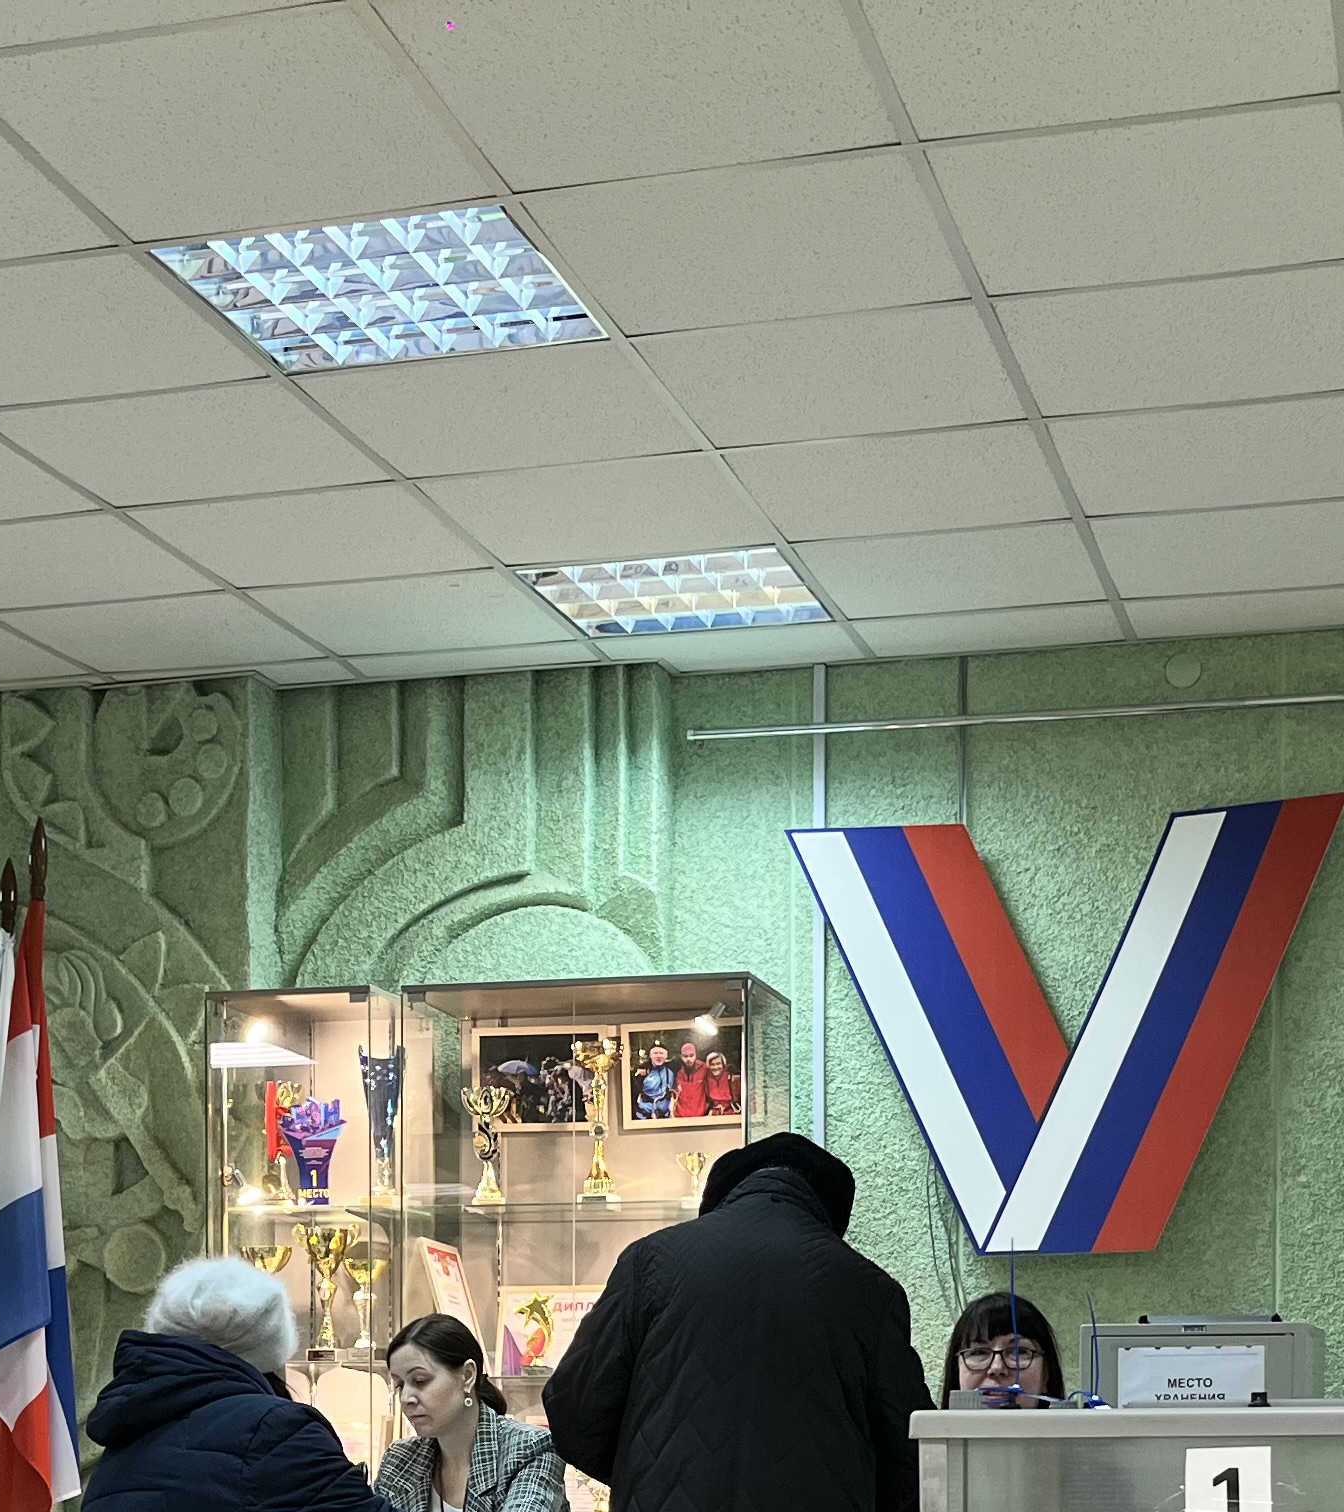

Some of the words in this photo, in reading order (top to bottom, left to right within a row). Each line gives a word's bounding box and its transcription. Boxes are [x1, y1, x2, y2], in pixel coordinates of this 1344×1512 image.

[309, 1168, 319, 1188] 1
[297, 1188, 331, 1199] МЕСТО
[552, 1301, 595, 1313] ДИПЛ
[1167, 1377, 1213, 1388] МЕСТО
